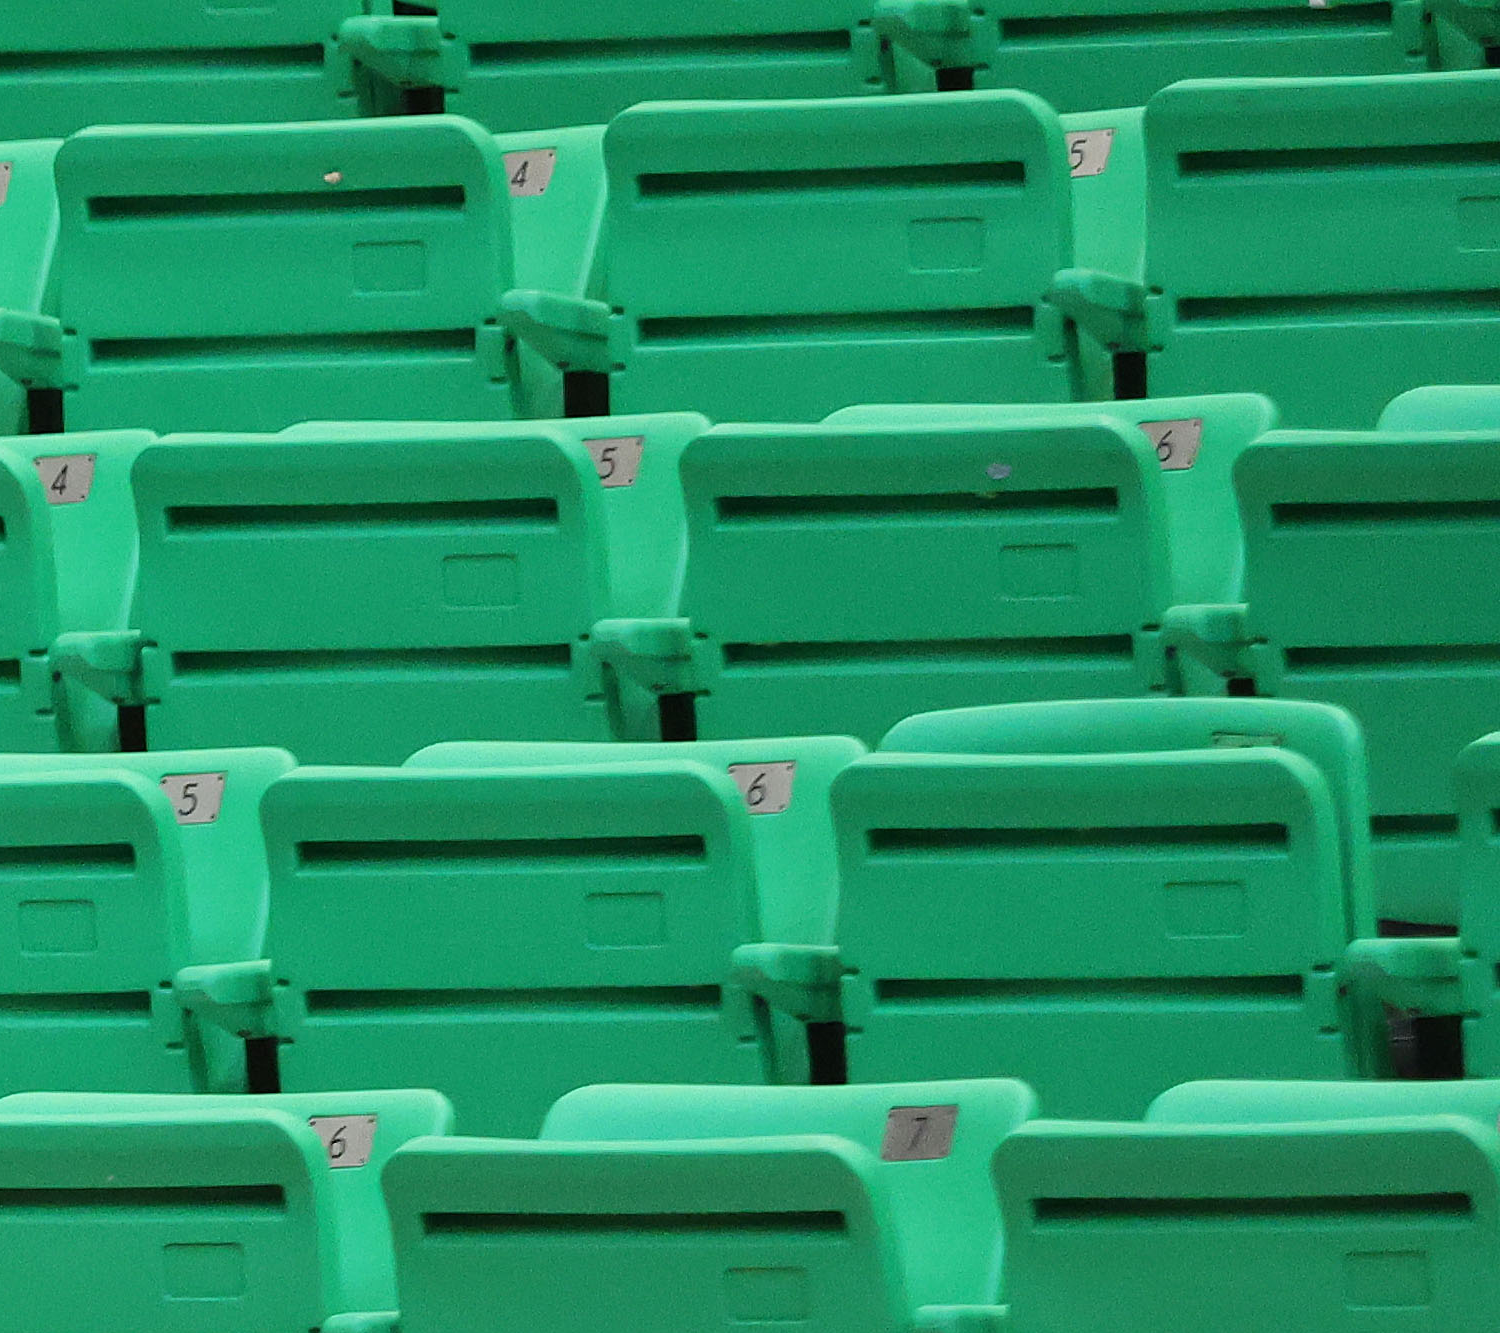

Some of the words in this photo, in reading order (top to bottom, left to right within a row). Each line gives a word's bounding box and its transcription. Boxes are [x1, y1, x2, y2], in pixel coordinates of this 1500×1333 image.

[1070, 139, 1088, 170] 5
[511, 161, 528, 187] 4
[1156, 430, 1173, 462] 6
[50, 464, 69, 495] 4
[600, 447, 618, 480] 5
[178, 783, 199, 816] 5
[746, 773, 766, 806] 6
[328, 1126, 347, 1159] 6
[907, 1117, 927, 1151] 7
